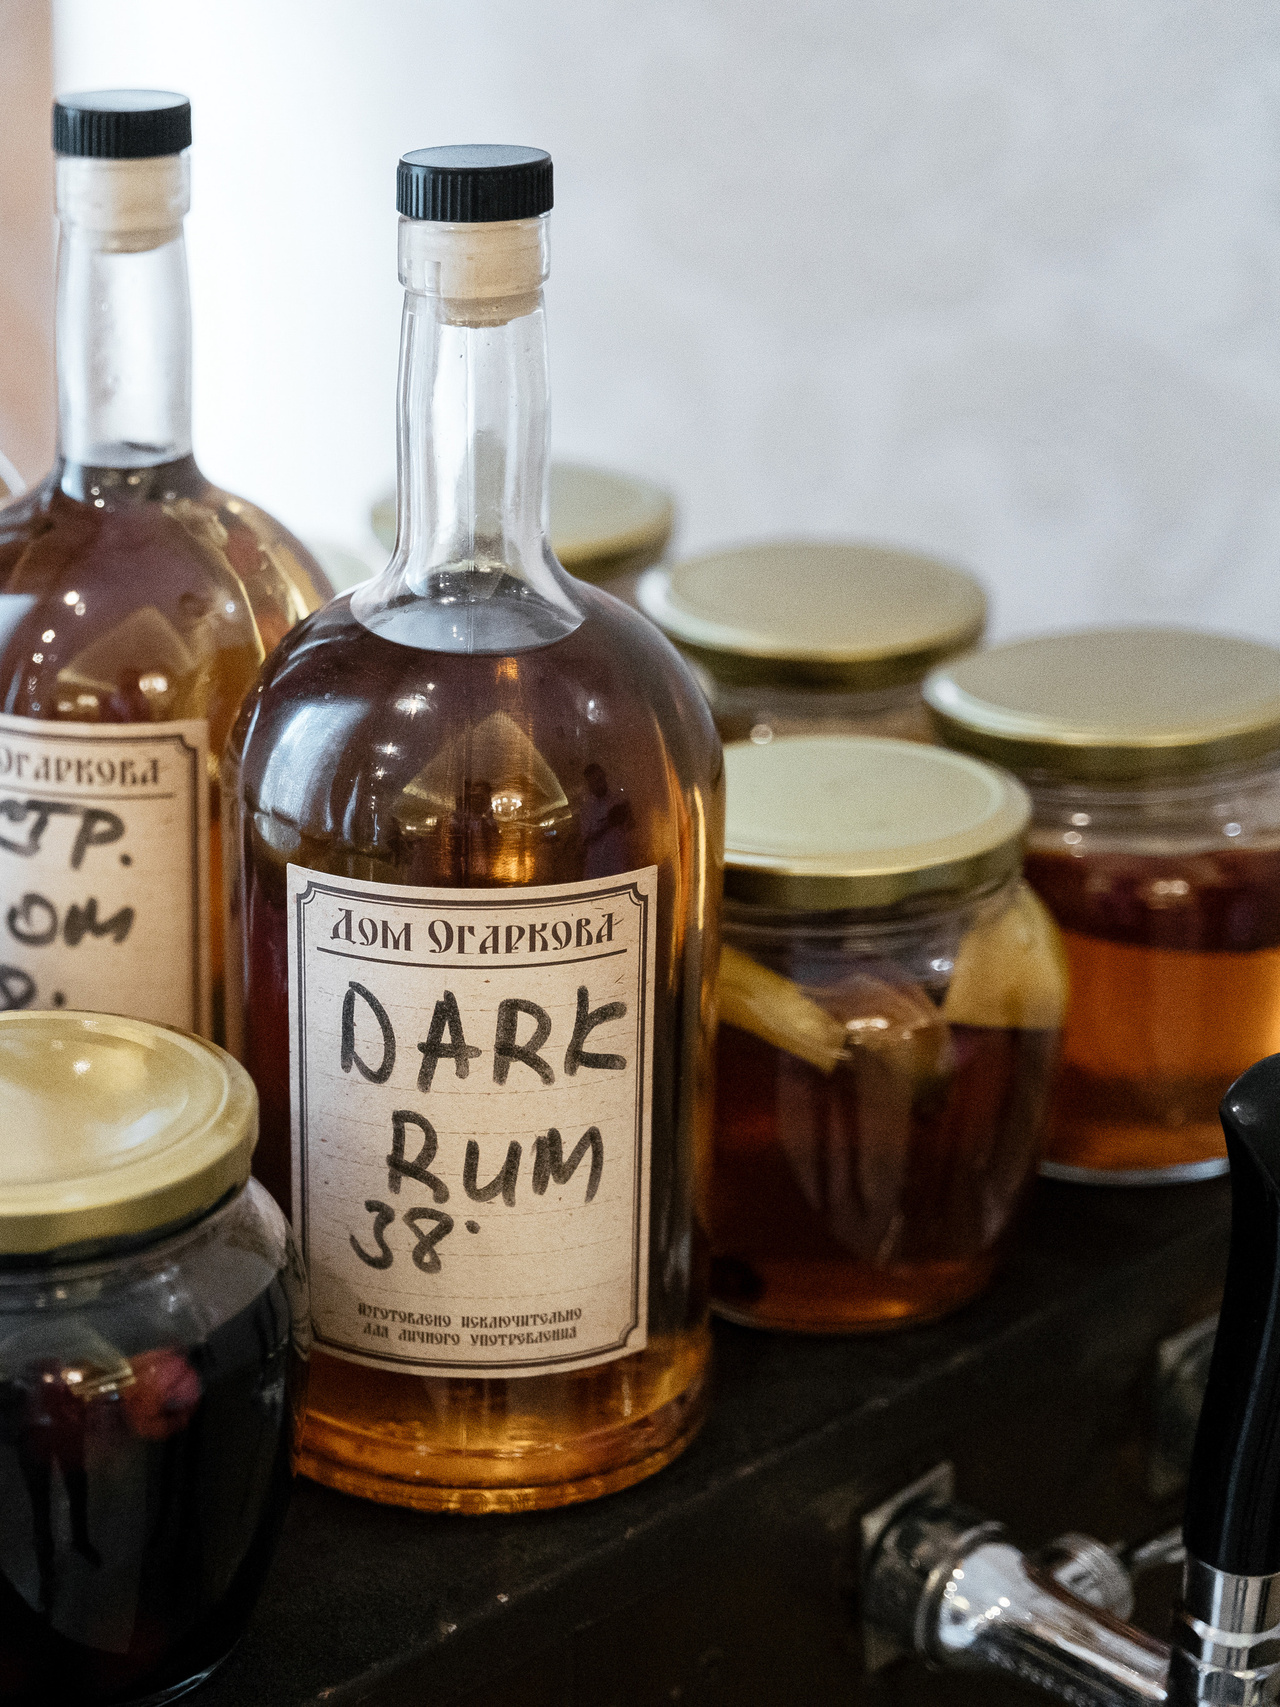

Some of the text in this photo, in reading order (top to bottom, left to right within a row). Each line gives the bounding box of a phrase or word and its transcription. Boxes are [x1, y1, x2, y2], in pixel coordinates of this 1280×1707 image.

[330, 908, 617, 955] ДОМ ОГАРКОВА
[340, 981, 628, 1094] DARK
[387, 1109, 604, 1208] RUM
[357, 1302, 583, 1329] ИЗГОТОВЛЕНО ИСКЛЮЧИТЕЛЬНО
[398, 1328, 460, 1346] ЛИЧНОГО
[470, 1326, 578, 1347] УПОТРЕБЛЕНИЯ
